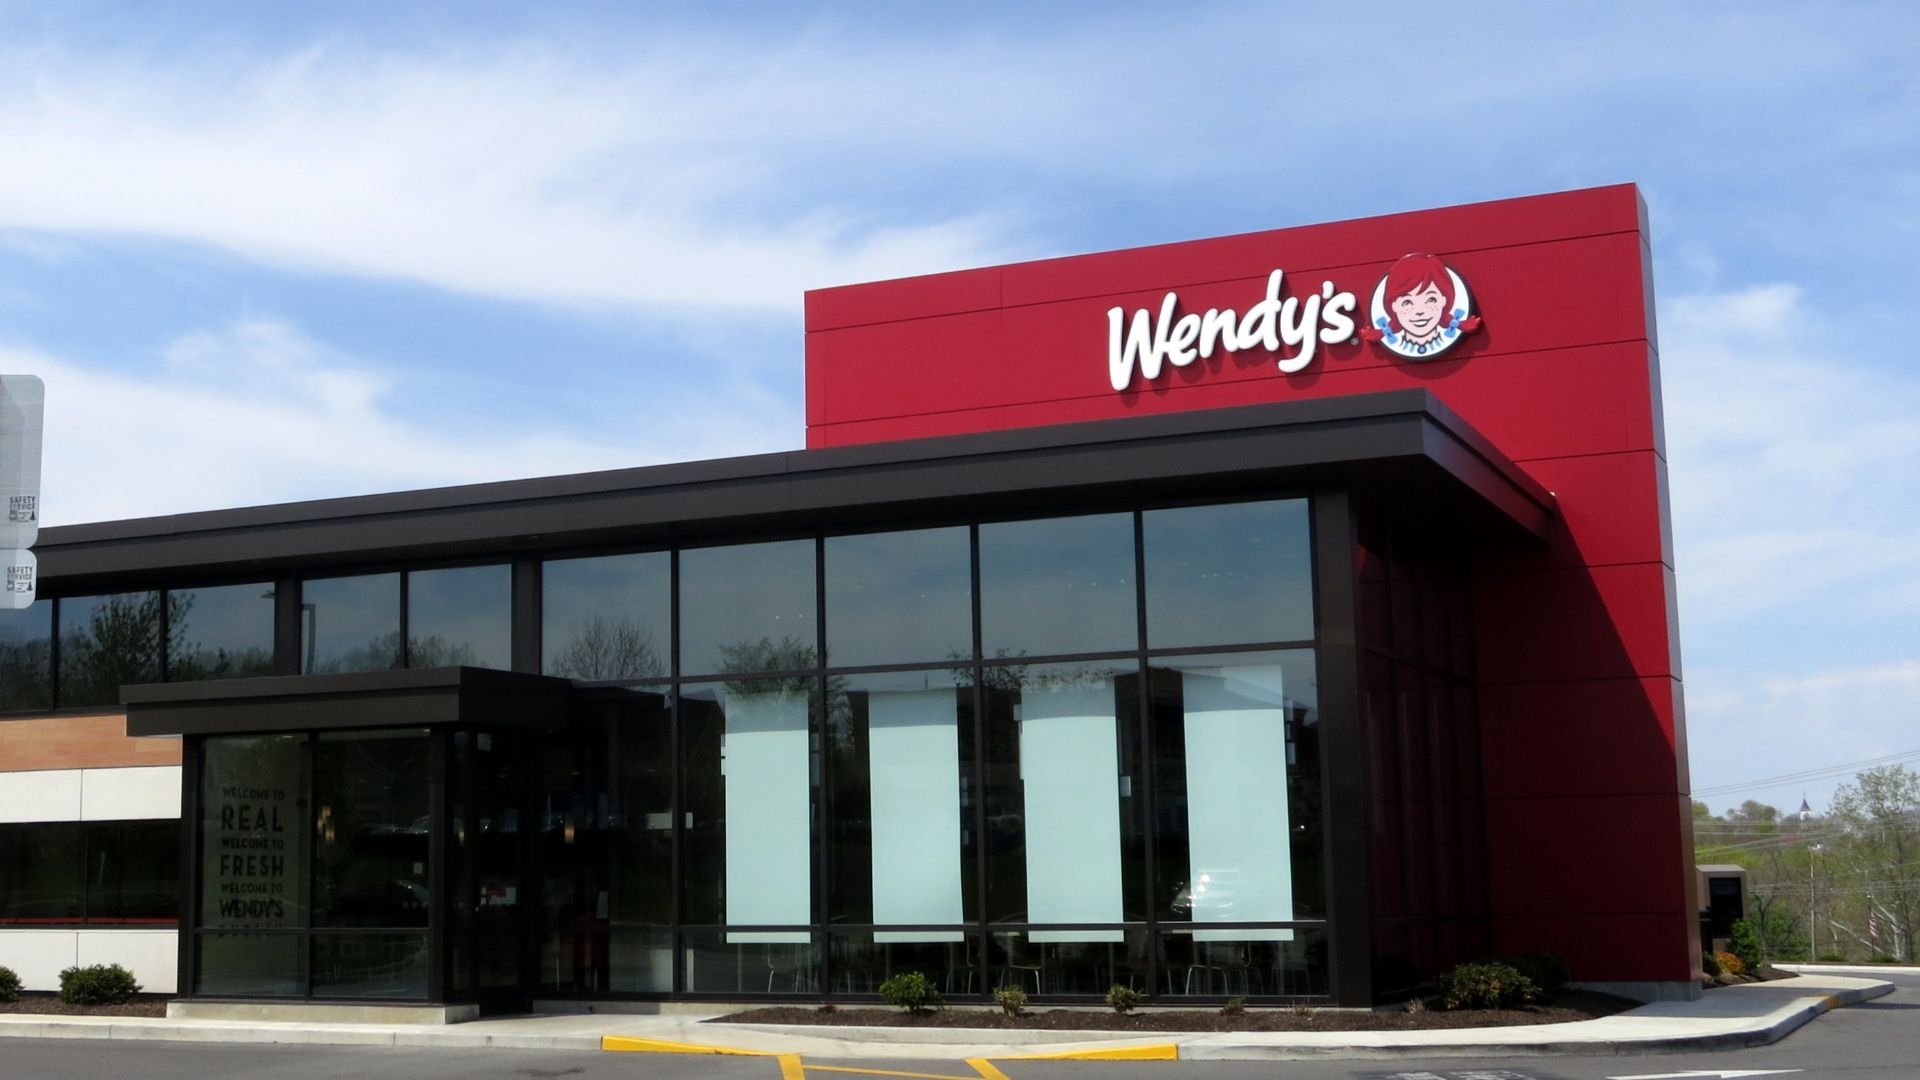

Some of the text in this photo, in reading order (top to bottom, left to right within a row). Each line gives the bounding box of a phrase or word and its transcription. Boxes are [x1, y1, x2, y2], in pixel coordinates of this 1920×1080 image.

[1108, 269, 1356, 391] Wendy's
[9, 496, 36, 504] SAFETY
[222, 787, 285, 800] WELCOME TO
[221, 804, 284, 832] REAL
[221, 837, 284, 849] WELCOME TO
[219, 855, 284, 877] FRESH
[220, 882, 284, 894] WELCOME TO
[219, 898, 284, 918] WENDY'S
